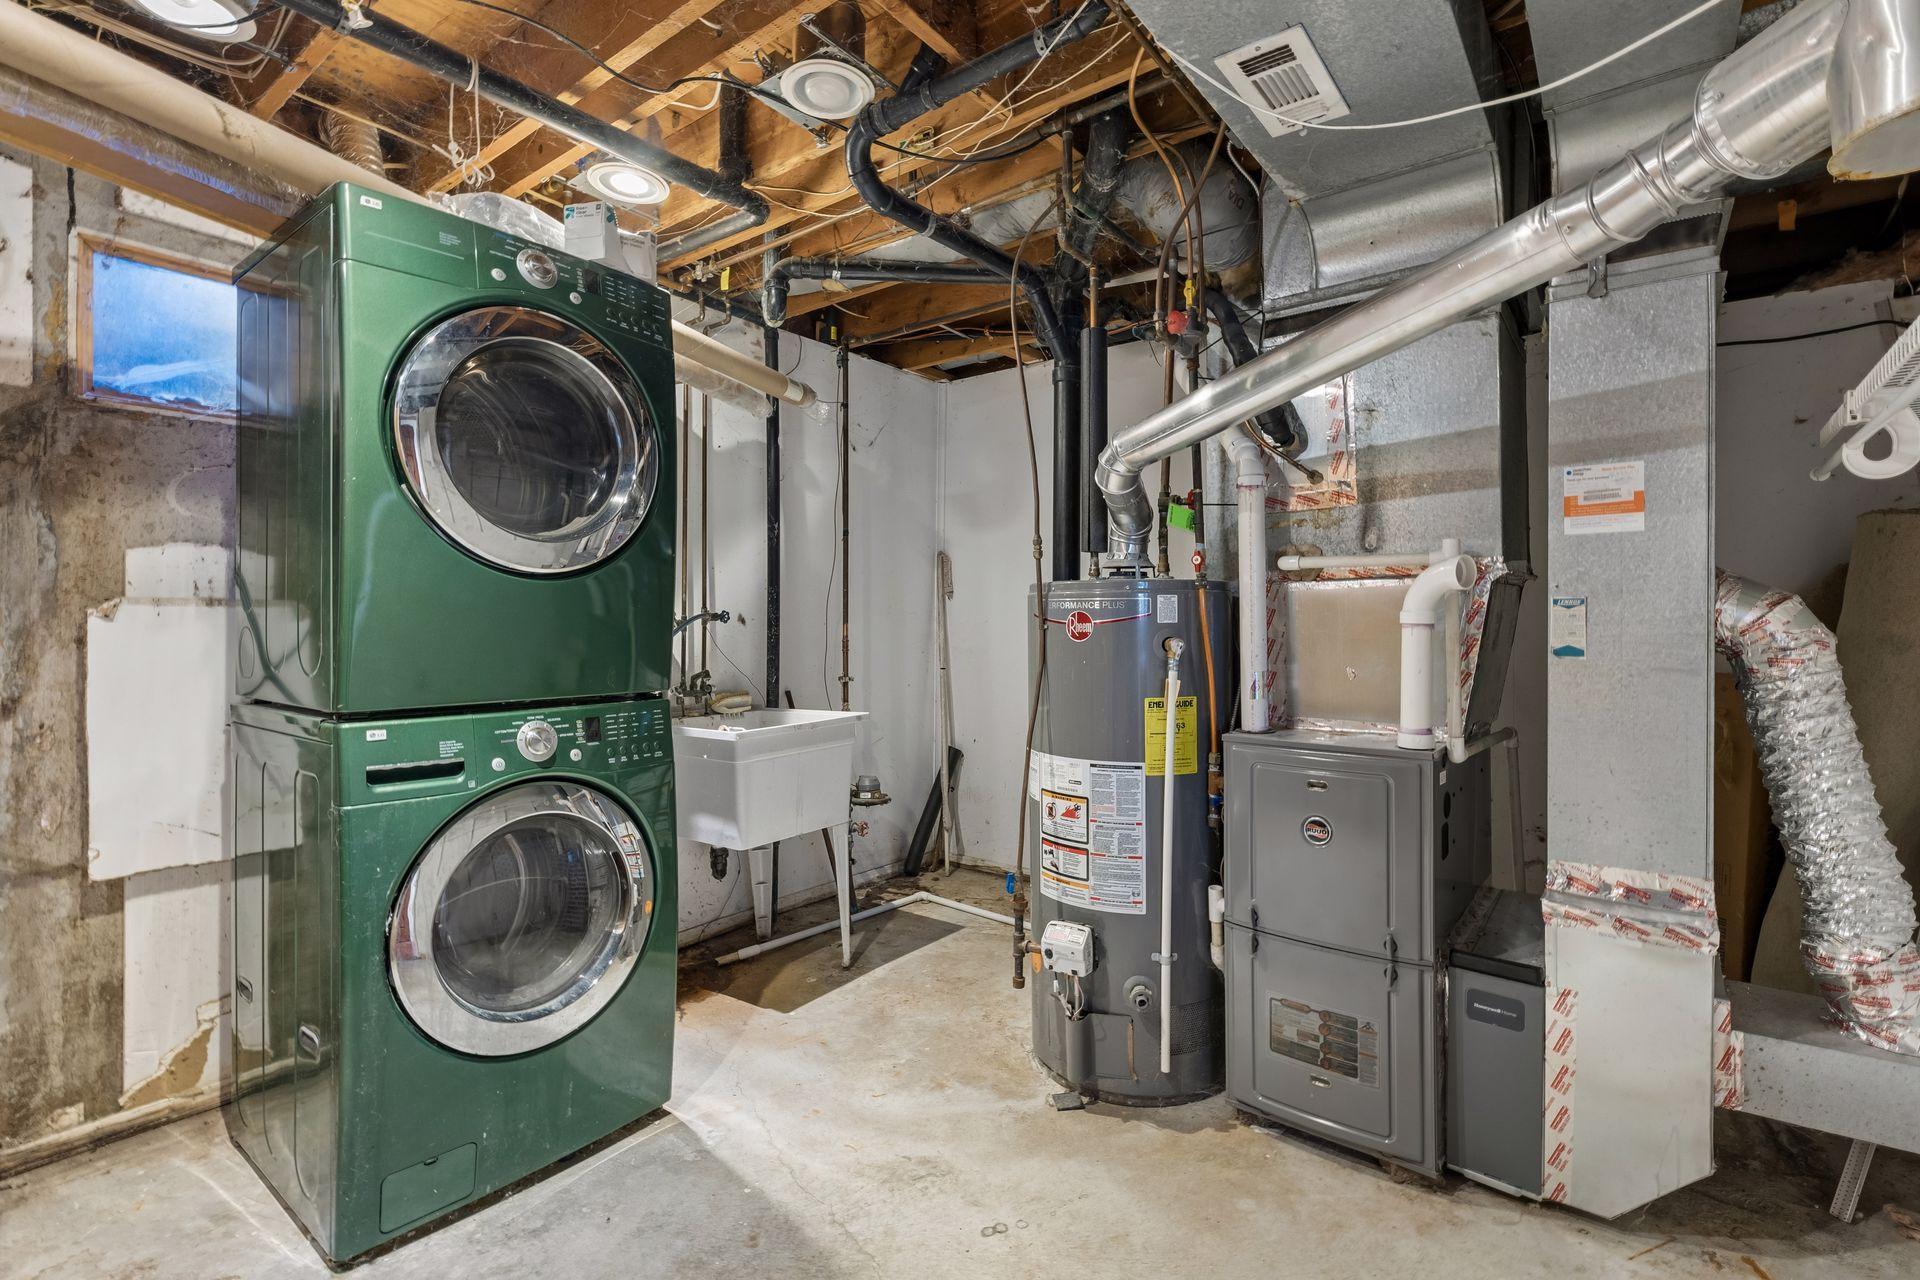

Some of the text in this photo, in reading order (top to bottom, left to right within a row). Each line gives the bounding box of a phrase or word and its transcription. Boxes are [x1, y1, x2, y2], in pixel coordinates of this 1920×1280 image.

[1048, 600, 1125, 609] ERFORMANCE PLUS
[1068, 611, 1092, 637] Rheem
[1307, 826, 1327, 835] RUUD
[1473, 1002, 1501, 1013] Honeywell
